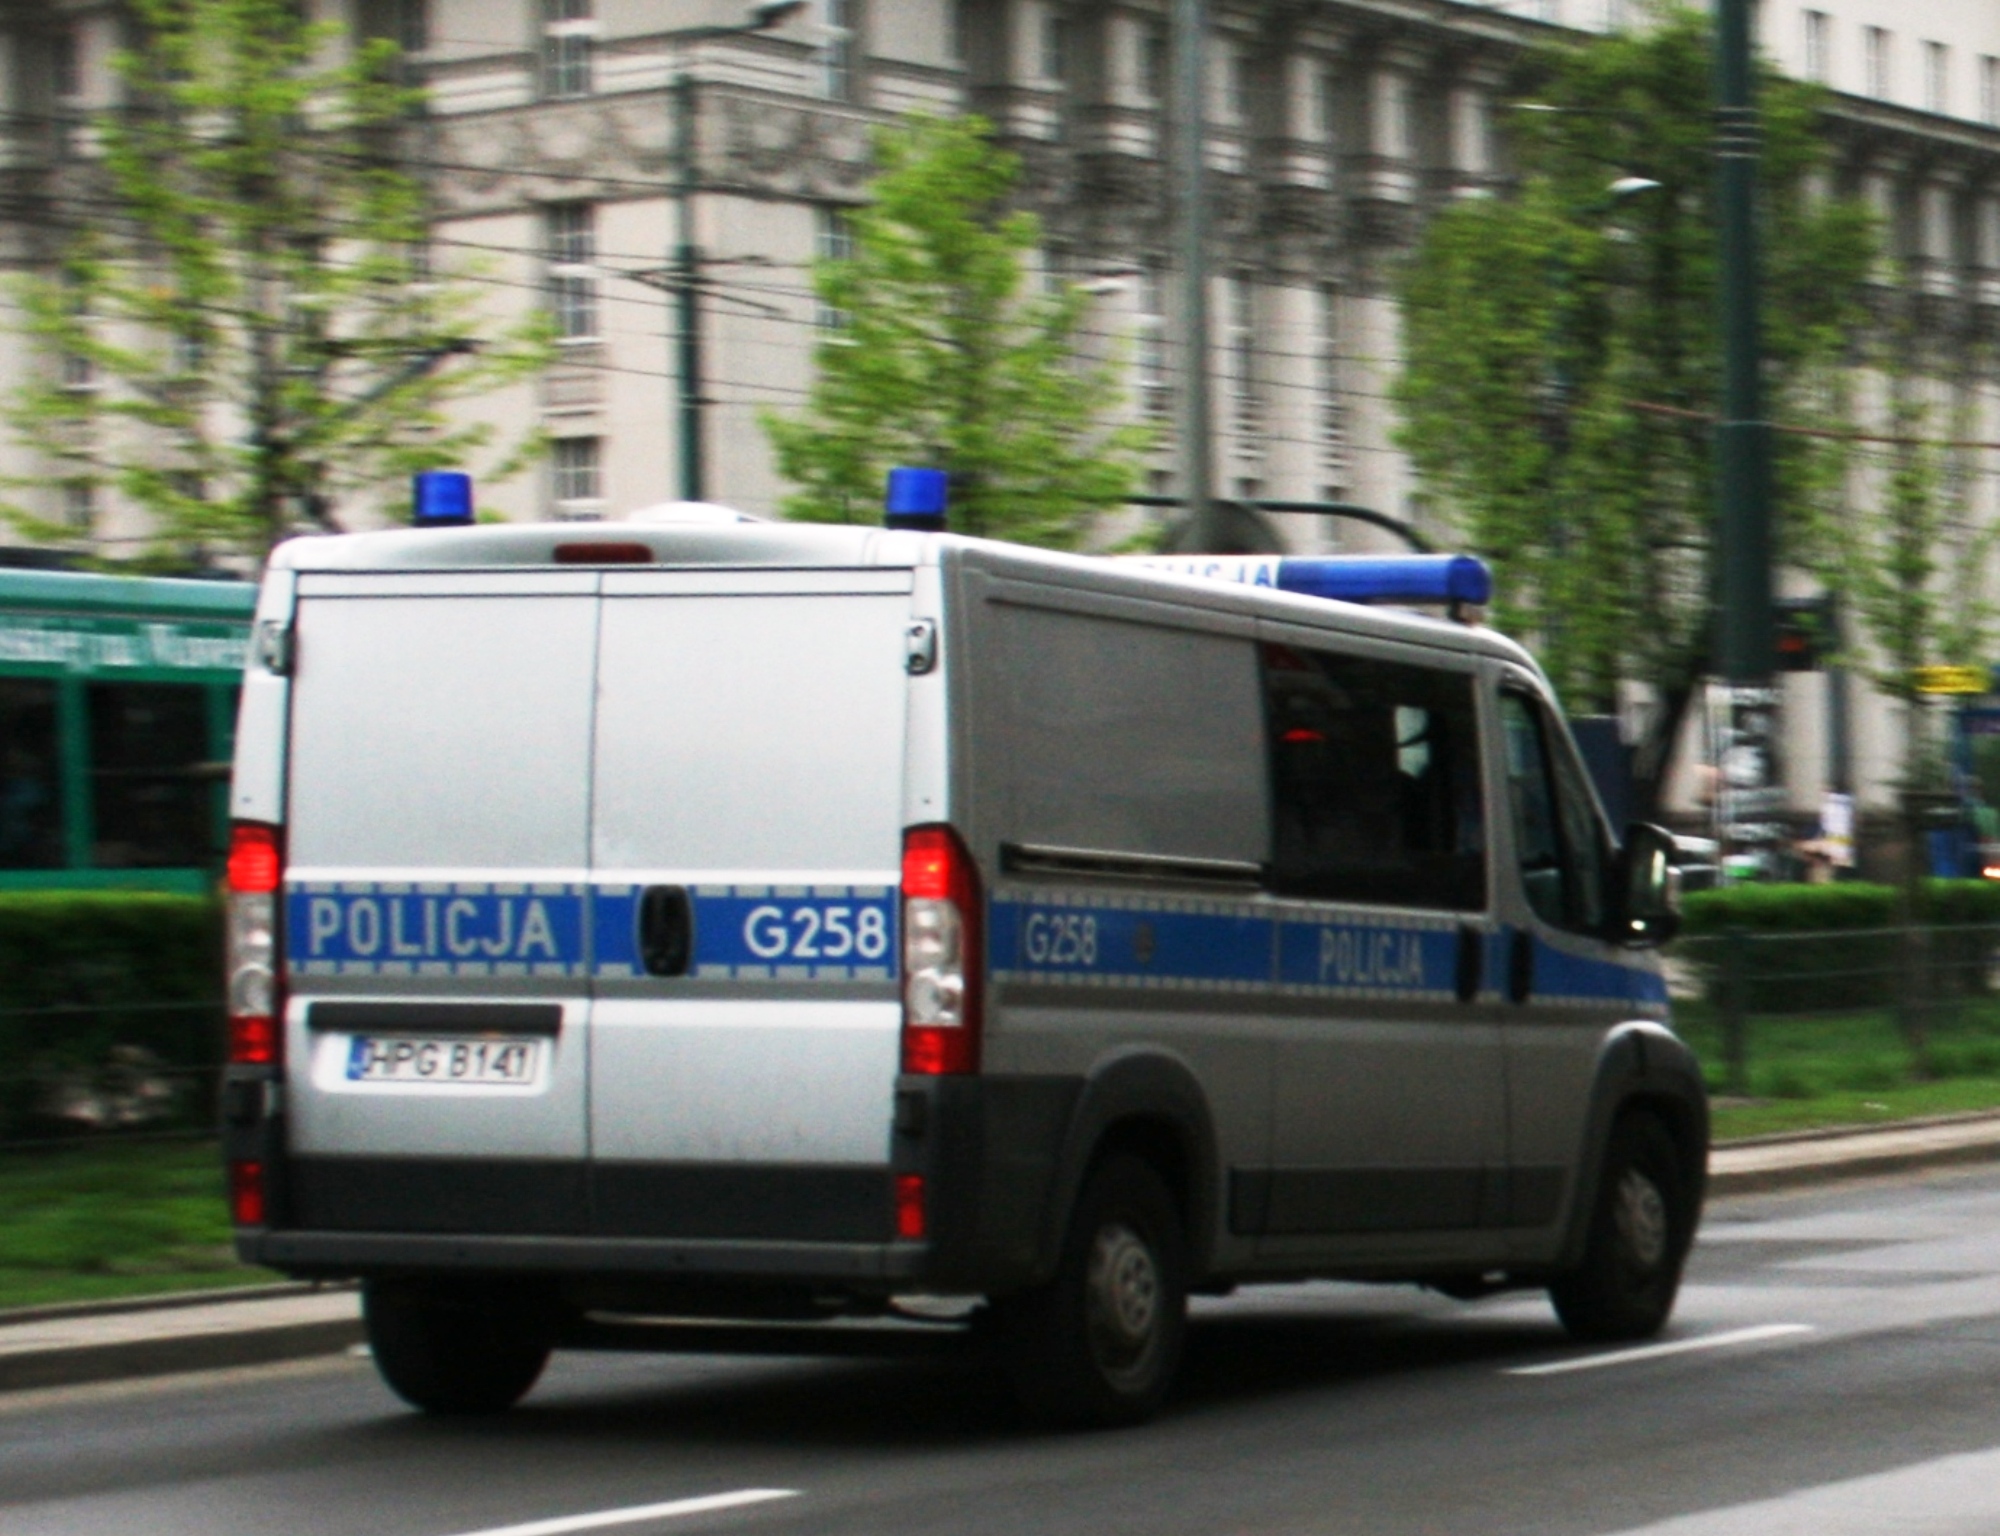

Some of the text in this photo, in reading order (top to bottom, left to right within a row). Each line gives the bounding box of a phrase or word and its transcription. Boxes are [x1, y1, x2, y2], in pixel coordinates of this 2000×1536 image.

[309, 897, 558, 957] POLICJA
[743, 905, 888, 958] G258
[1024, 912, 1098, 965] G258
[1319, 927, 1424, 986] POLICJA
[363, 1041, 438, 1076] HPG
